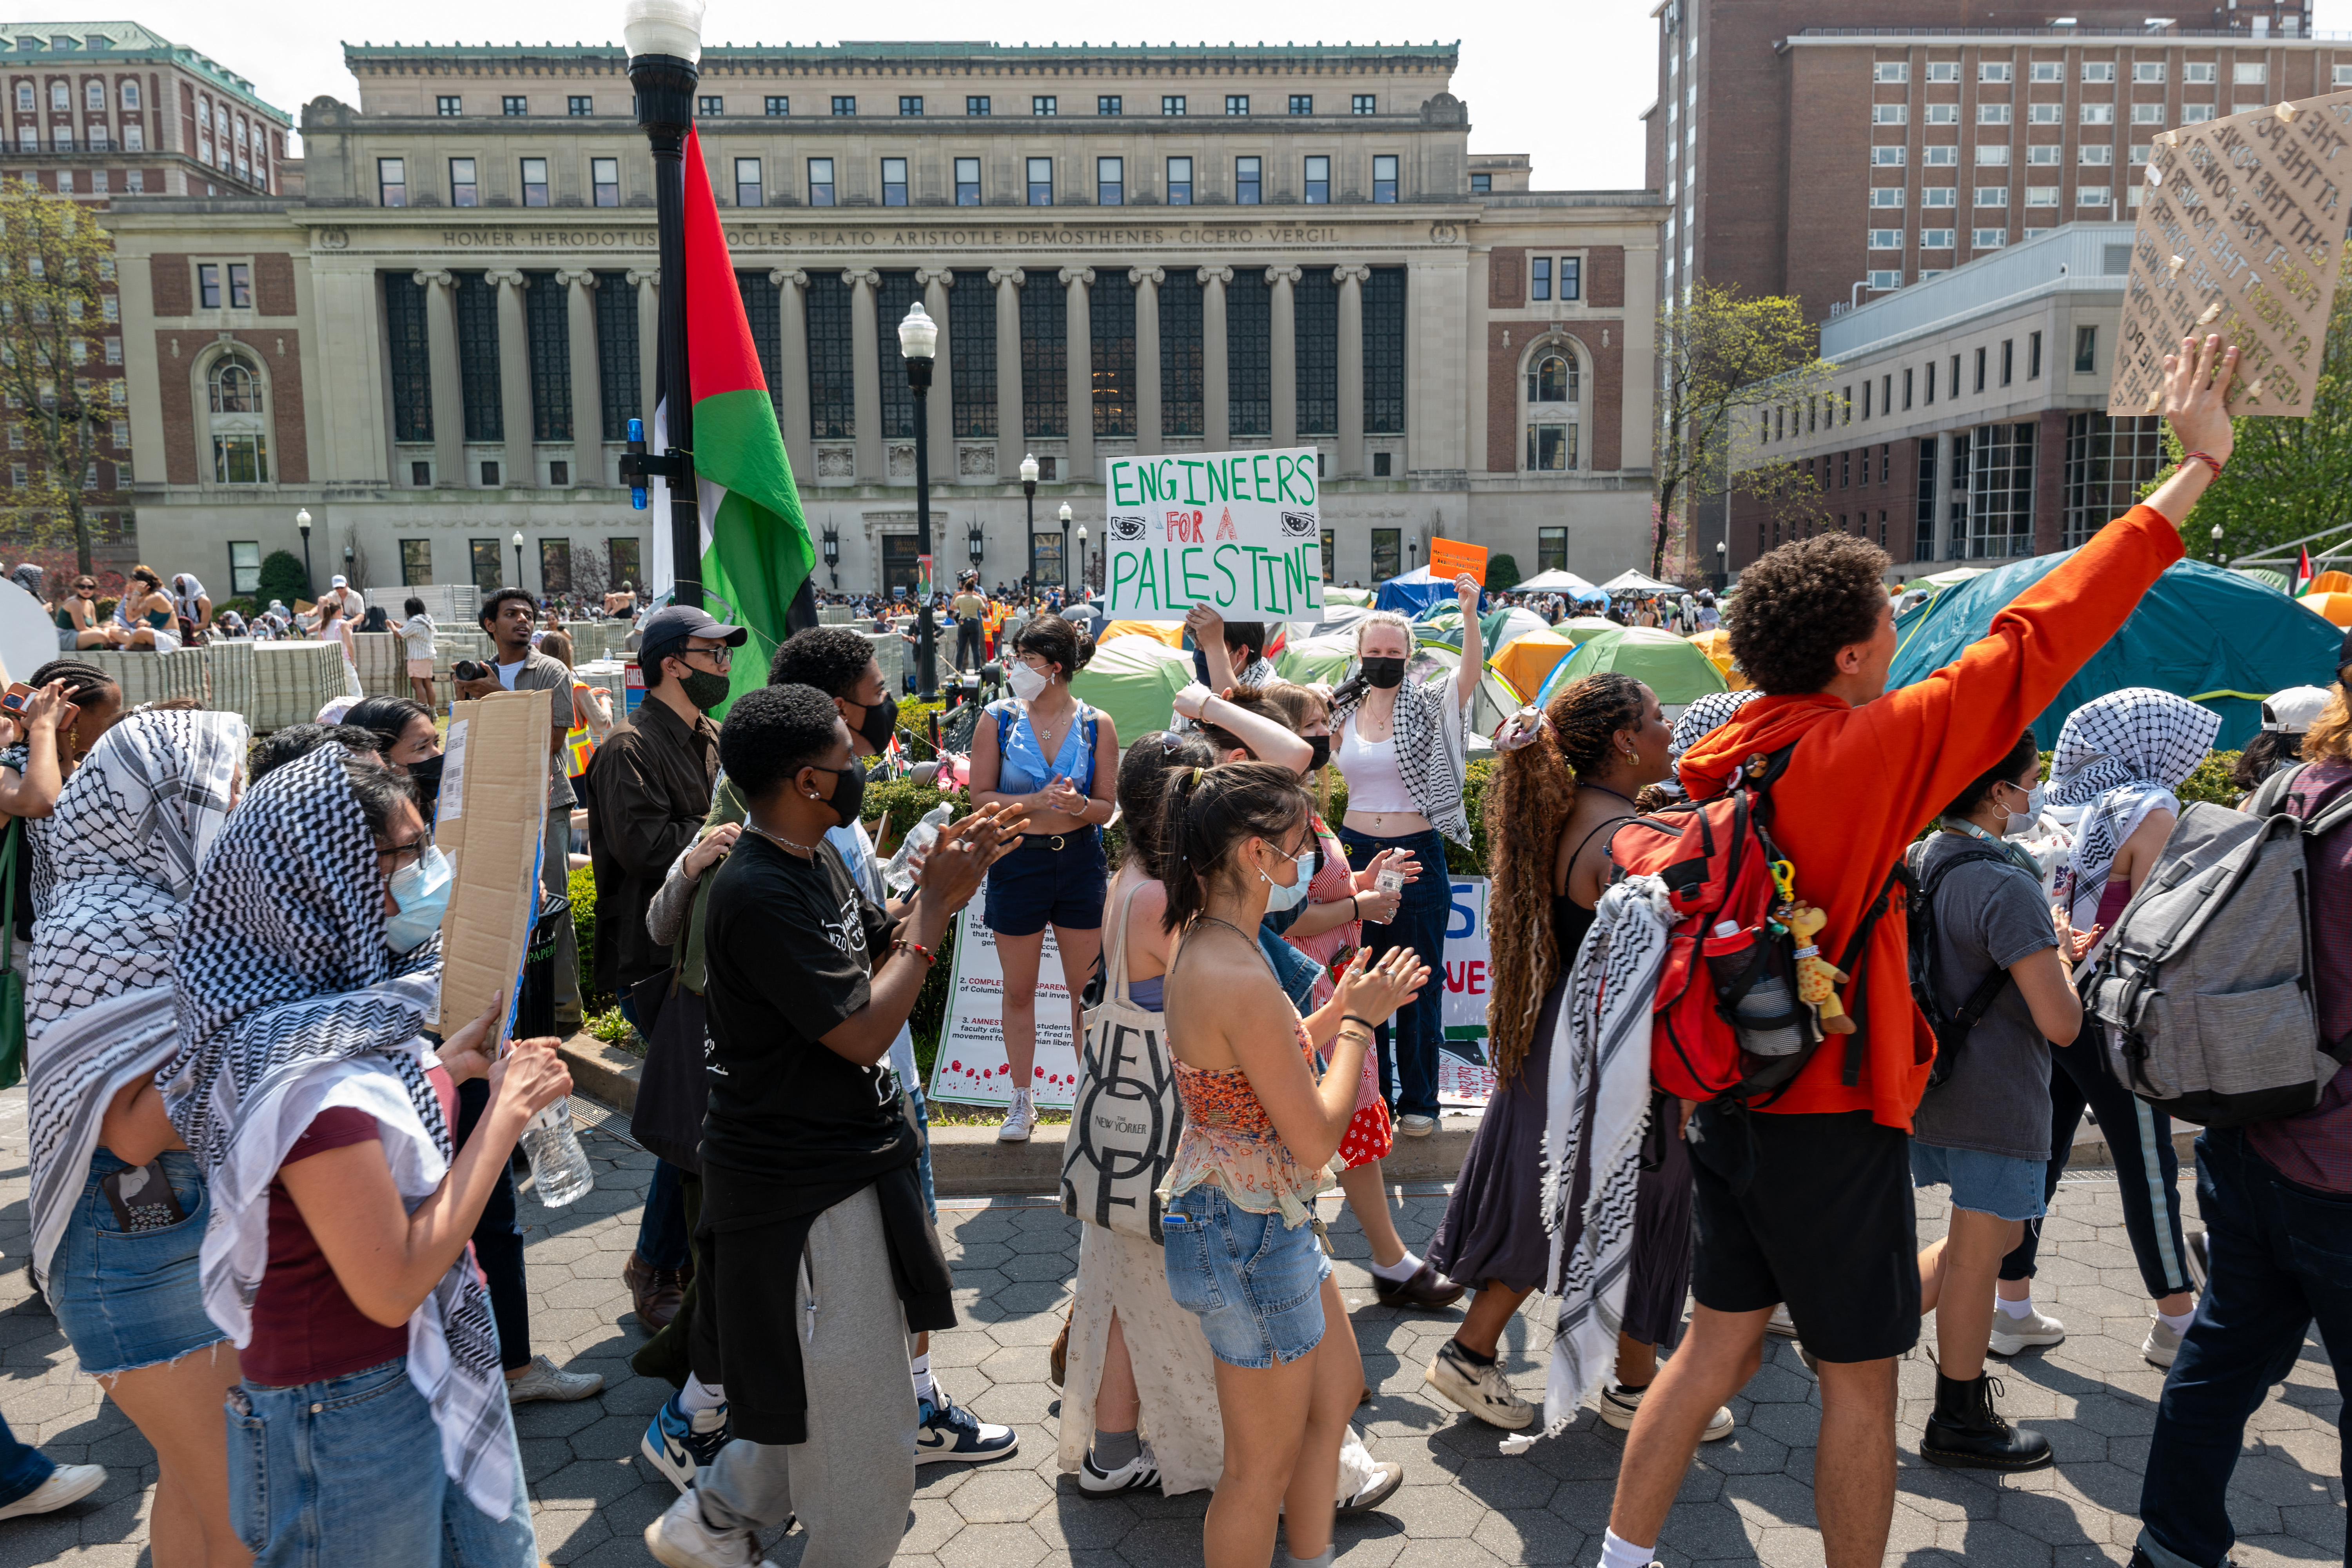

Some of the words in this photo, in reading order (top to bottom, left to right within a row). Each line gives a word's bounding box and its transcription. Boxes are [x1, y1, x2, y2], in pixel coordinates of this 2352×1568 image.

[443, 232, 514, 247] HOMER
[529, 232, 657, 247] HERODOTUS
[726, 231, 791, 246] OCLES
[809, 231, 875, 246] PLATO
[892, 230, 1002, 246] ARISTOTLE
[1018, 230, 1164, 245] DEMOSTHENES
[1179, 229, 1253, 244] CICERO
[1268, 229, 1339, 243] VERGIL
[1112, 455, 1315, 506] ENGINEERS
[1166, 510, 1205, 543] FOR
[1216, 506, 1238, 541] A
[1111, 543, 1320, 615] PALESTINE
[527, 945, 554, 963] PAPER
[961, 1025, 988, 1033] faculty
[1095, 1115, 1114, 1129] NEW
[1114, 1121, 1147, 1134] YORKER
